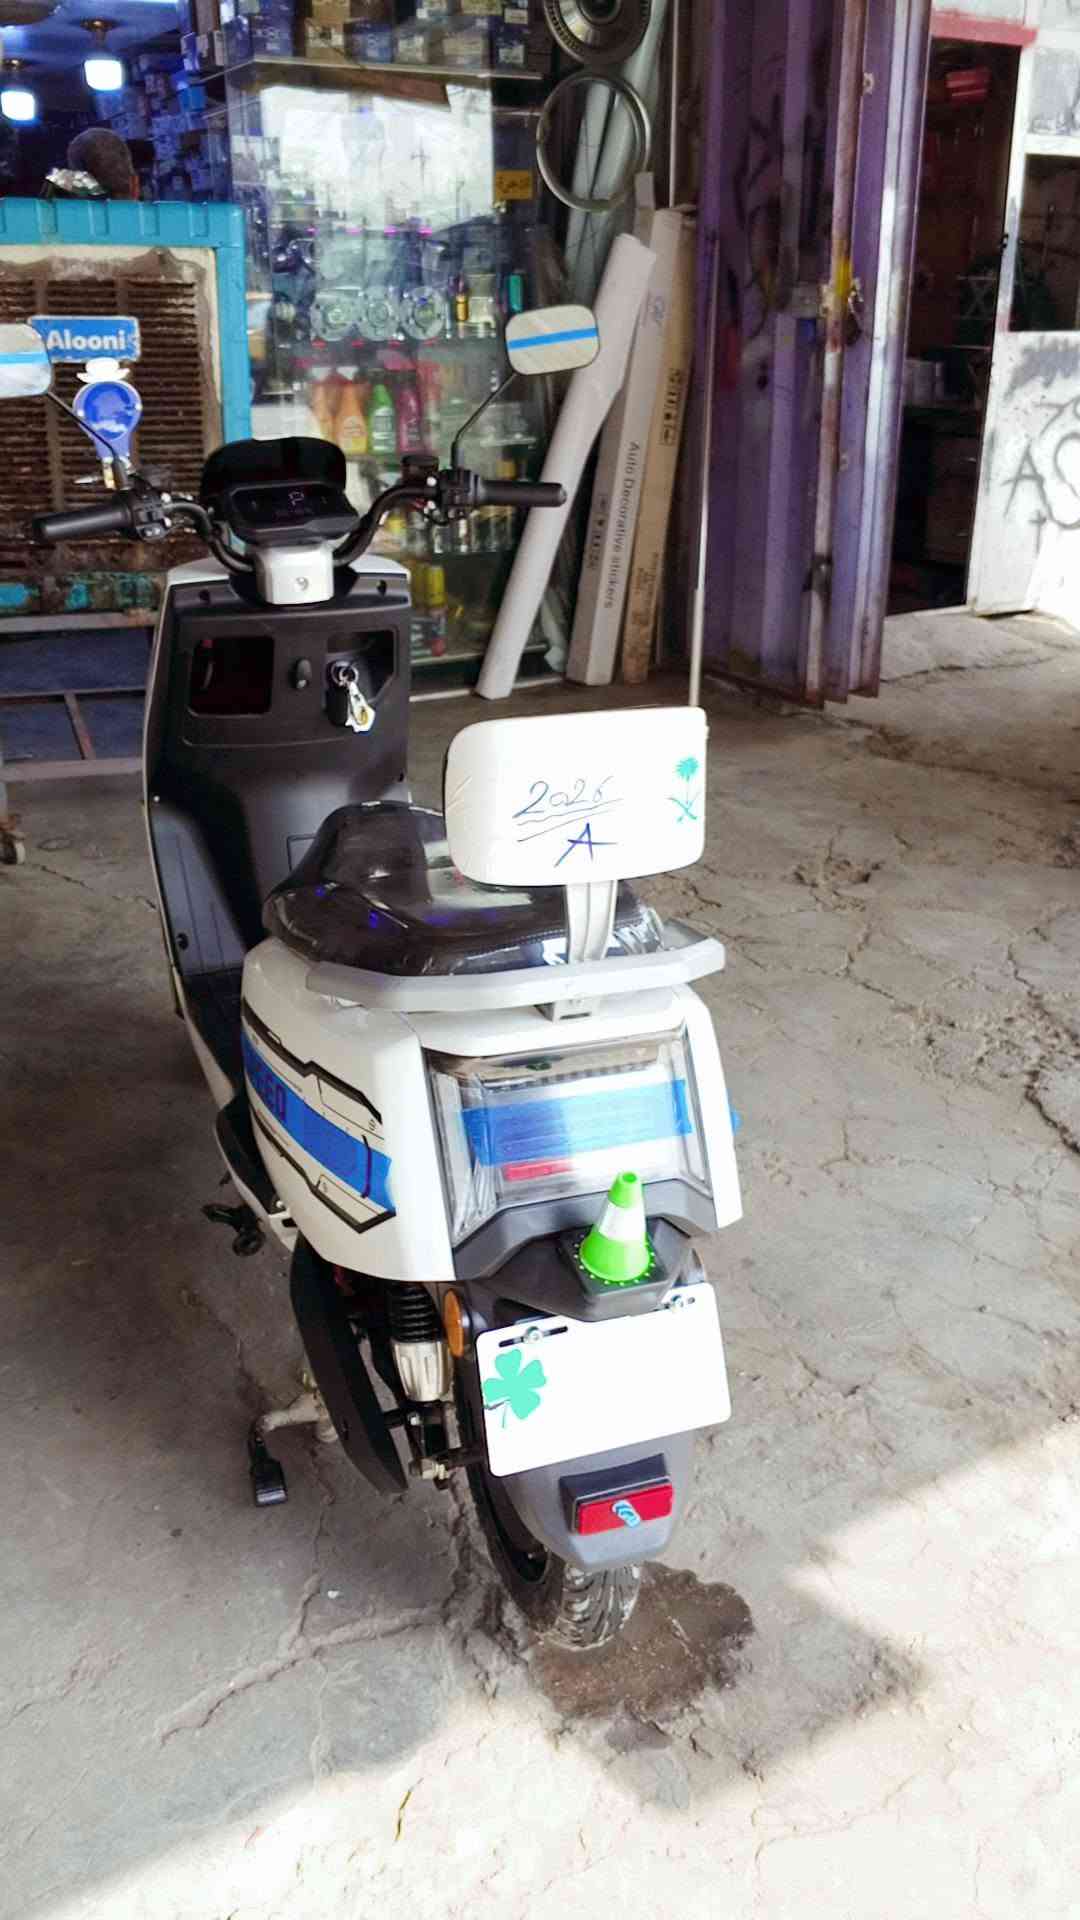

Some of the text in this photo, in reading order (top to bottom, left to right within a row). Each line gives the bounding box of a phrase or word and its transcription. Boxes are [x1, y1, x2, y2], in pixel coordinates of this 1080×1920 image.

[46, 328, 126, 350] Alooni
[603, 441, 641, 609] Auto Decorative stickers
